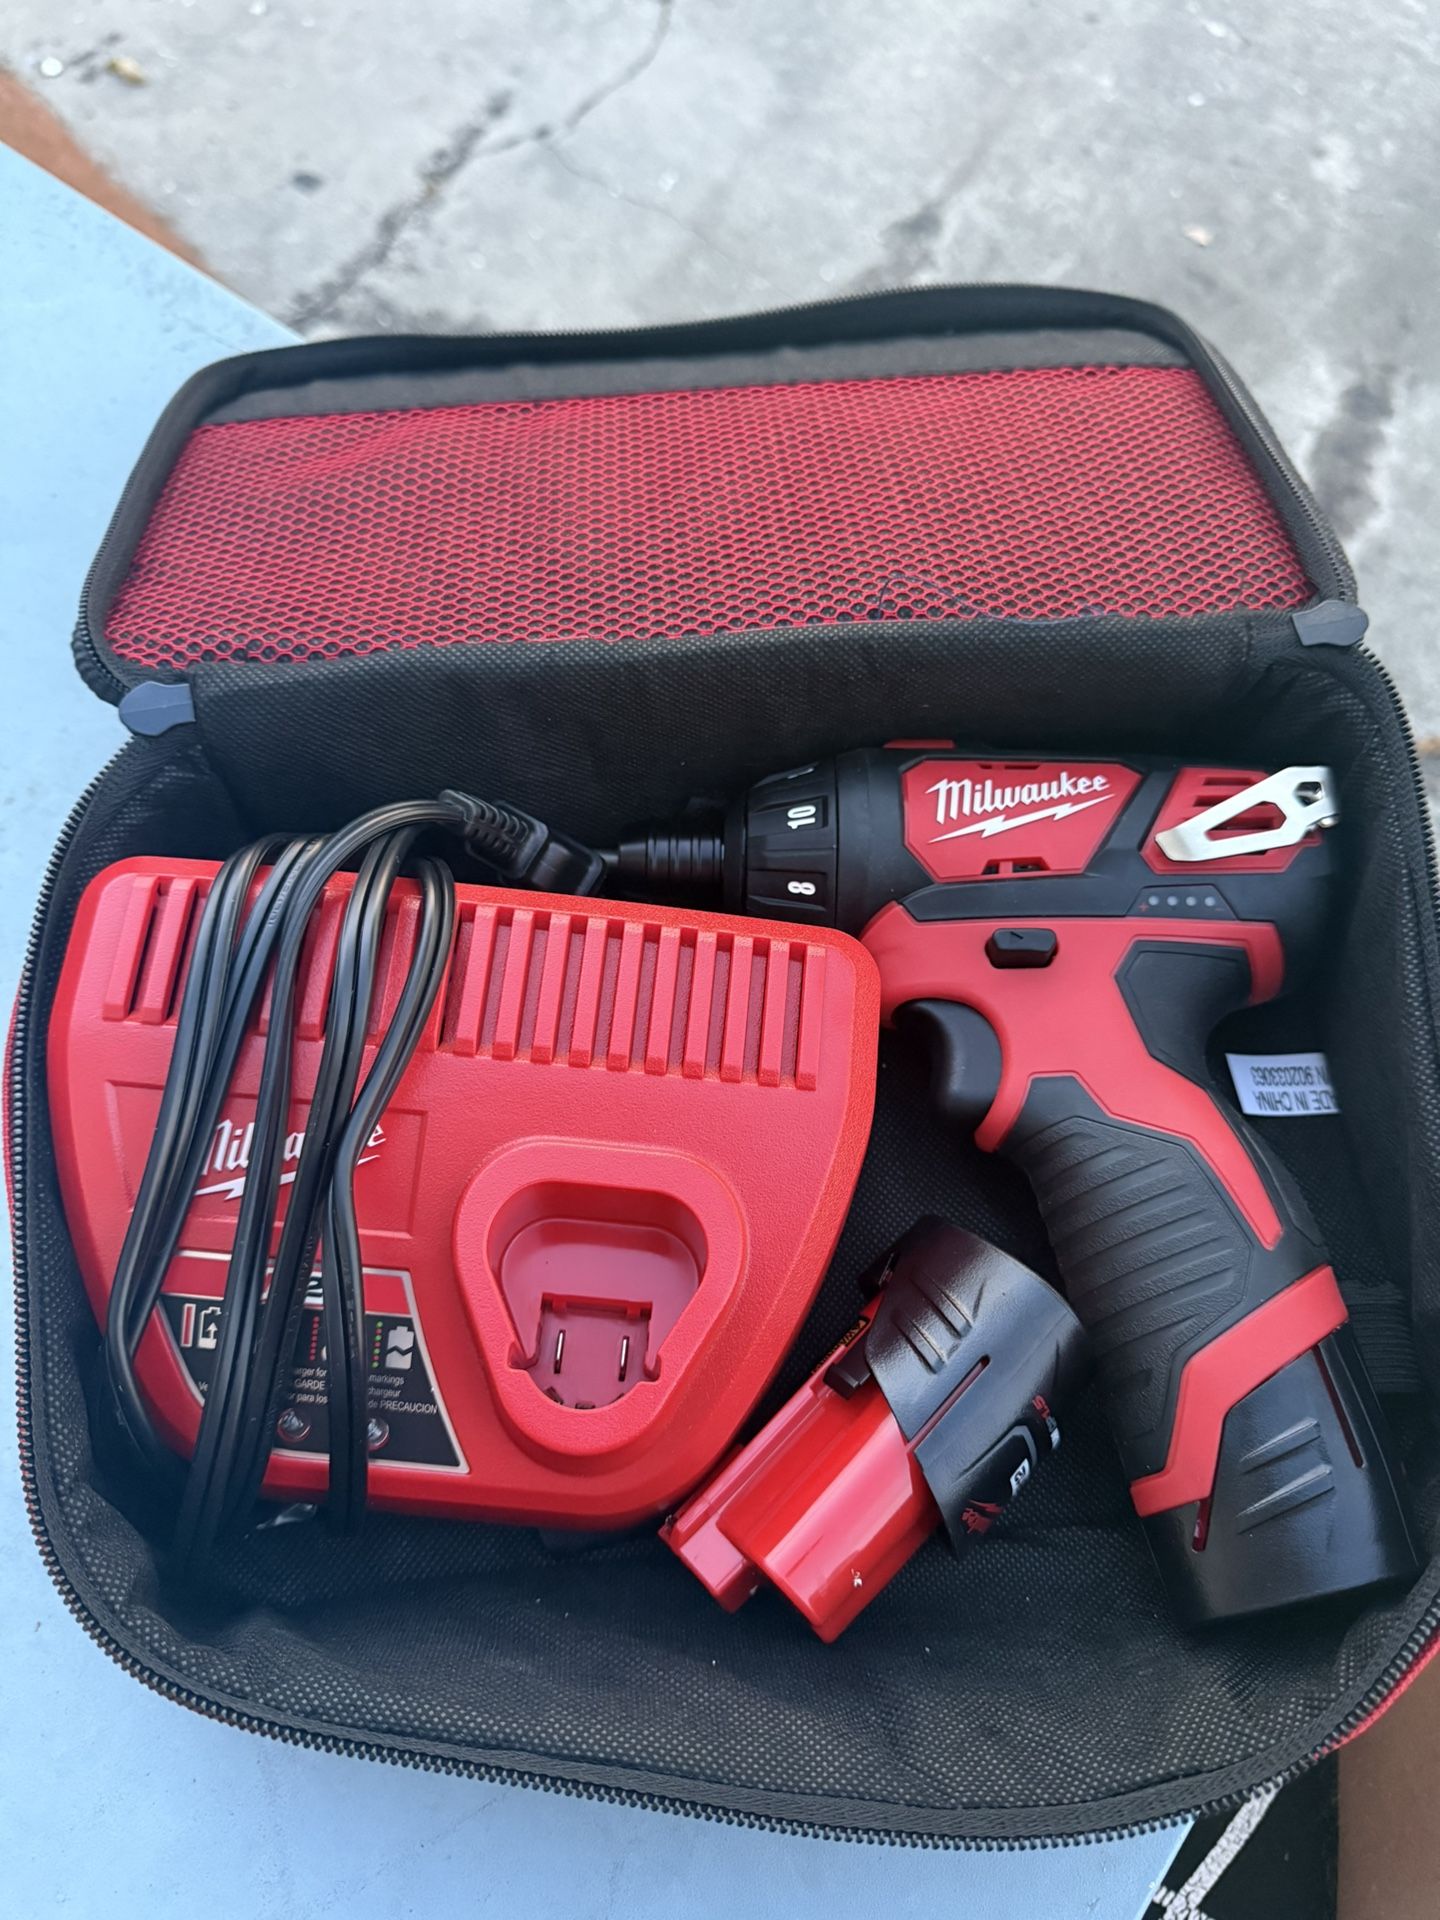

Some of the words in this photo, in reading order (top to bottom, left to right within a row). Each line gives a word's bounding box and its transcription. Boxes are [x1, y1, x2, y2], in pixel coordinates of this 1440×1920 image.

[925, 771, 1112, 825] Milwaukee
[787, 805, 816, 829] 10
[787, 881, 816, 895] 8
[1252, 1090, 1293, 1112] CHINA
